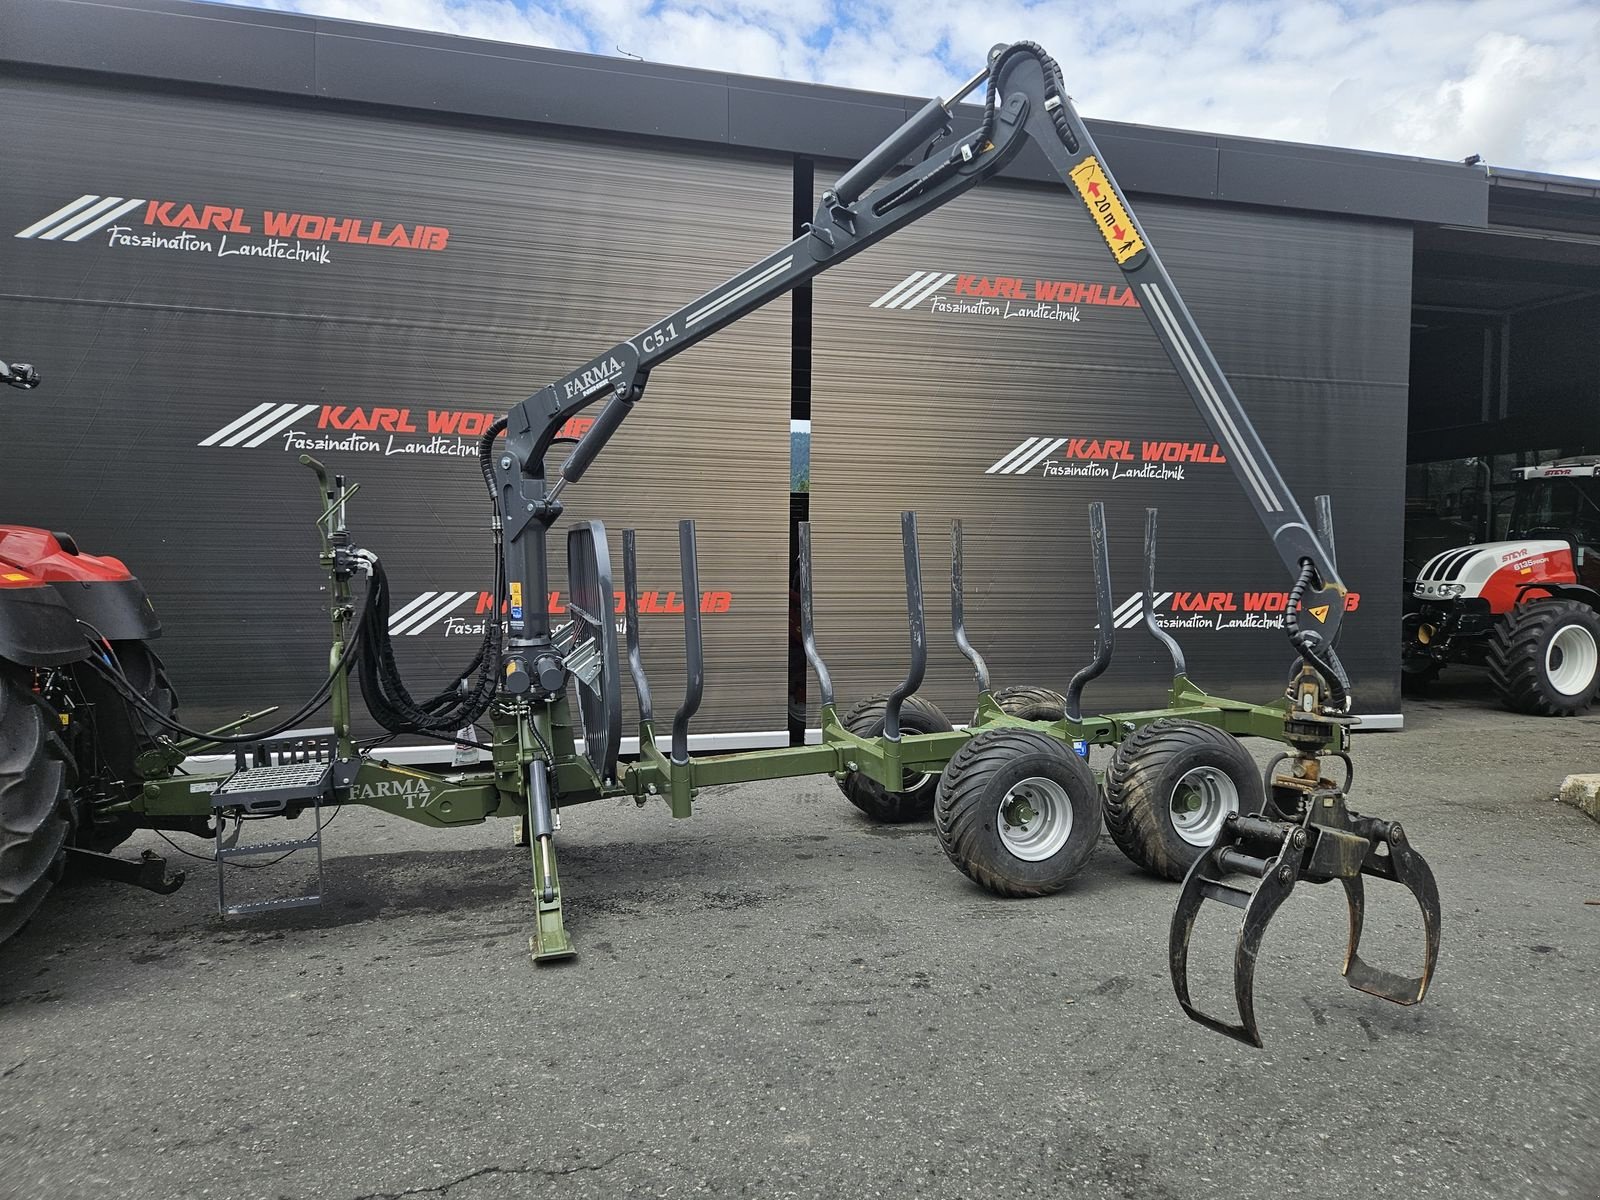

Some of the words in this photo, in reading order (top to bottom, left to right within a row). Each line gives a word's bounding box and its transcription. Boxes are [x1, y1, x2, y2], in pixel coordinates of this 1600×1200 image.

[1094, 195, 1111, 213] 20
[1103, 212, 1116, 227] m
[144, 200, 251, 233] KARL
[263, 211, 450, 251] WOHLLAIB
[107, 225, 212, 252] Faszination
[217, 235, 331, 264] Landtechnik
[956, 273, 1028, 299] KARL
[1034, 280, 1141, 308] WOHLLA
[931, 295, 1000, 316] Faszination
[1003, 301, 1081, 323] Landtechnik
[564, 357, 622, 399] FARMA
[642, 322, 679, 353] C5.1
[317, 405, 417, 434] KARL
[283, 430, 381, 452] Faszination
[385, 435, 481, 457] Landtechni
[1066, 438, 1135, 461] KARL
[1142, 441, 1227, 464] WOHLL
[1042, 459, 1109, 478] Faszination
[1112, 462, 1185, 481] Landtechnik
[1501, 548, 1528, 562] STEYR
[1171, 592, 1237, 611] KARL
[1215, 613, 1285, 630] Landtechnik
[348, 778, 431, 801] FARMA
[402, 792, 431, 809] T7
